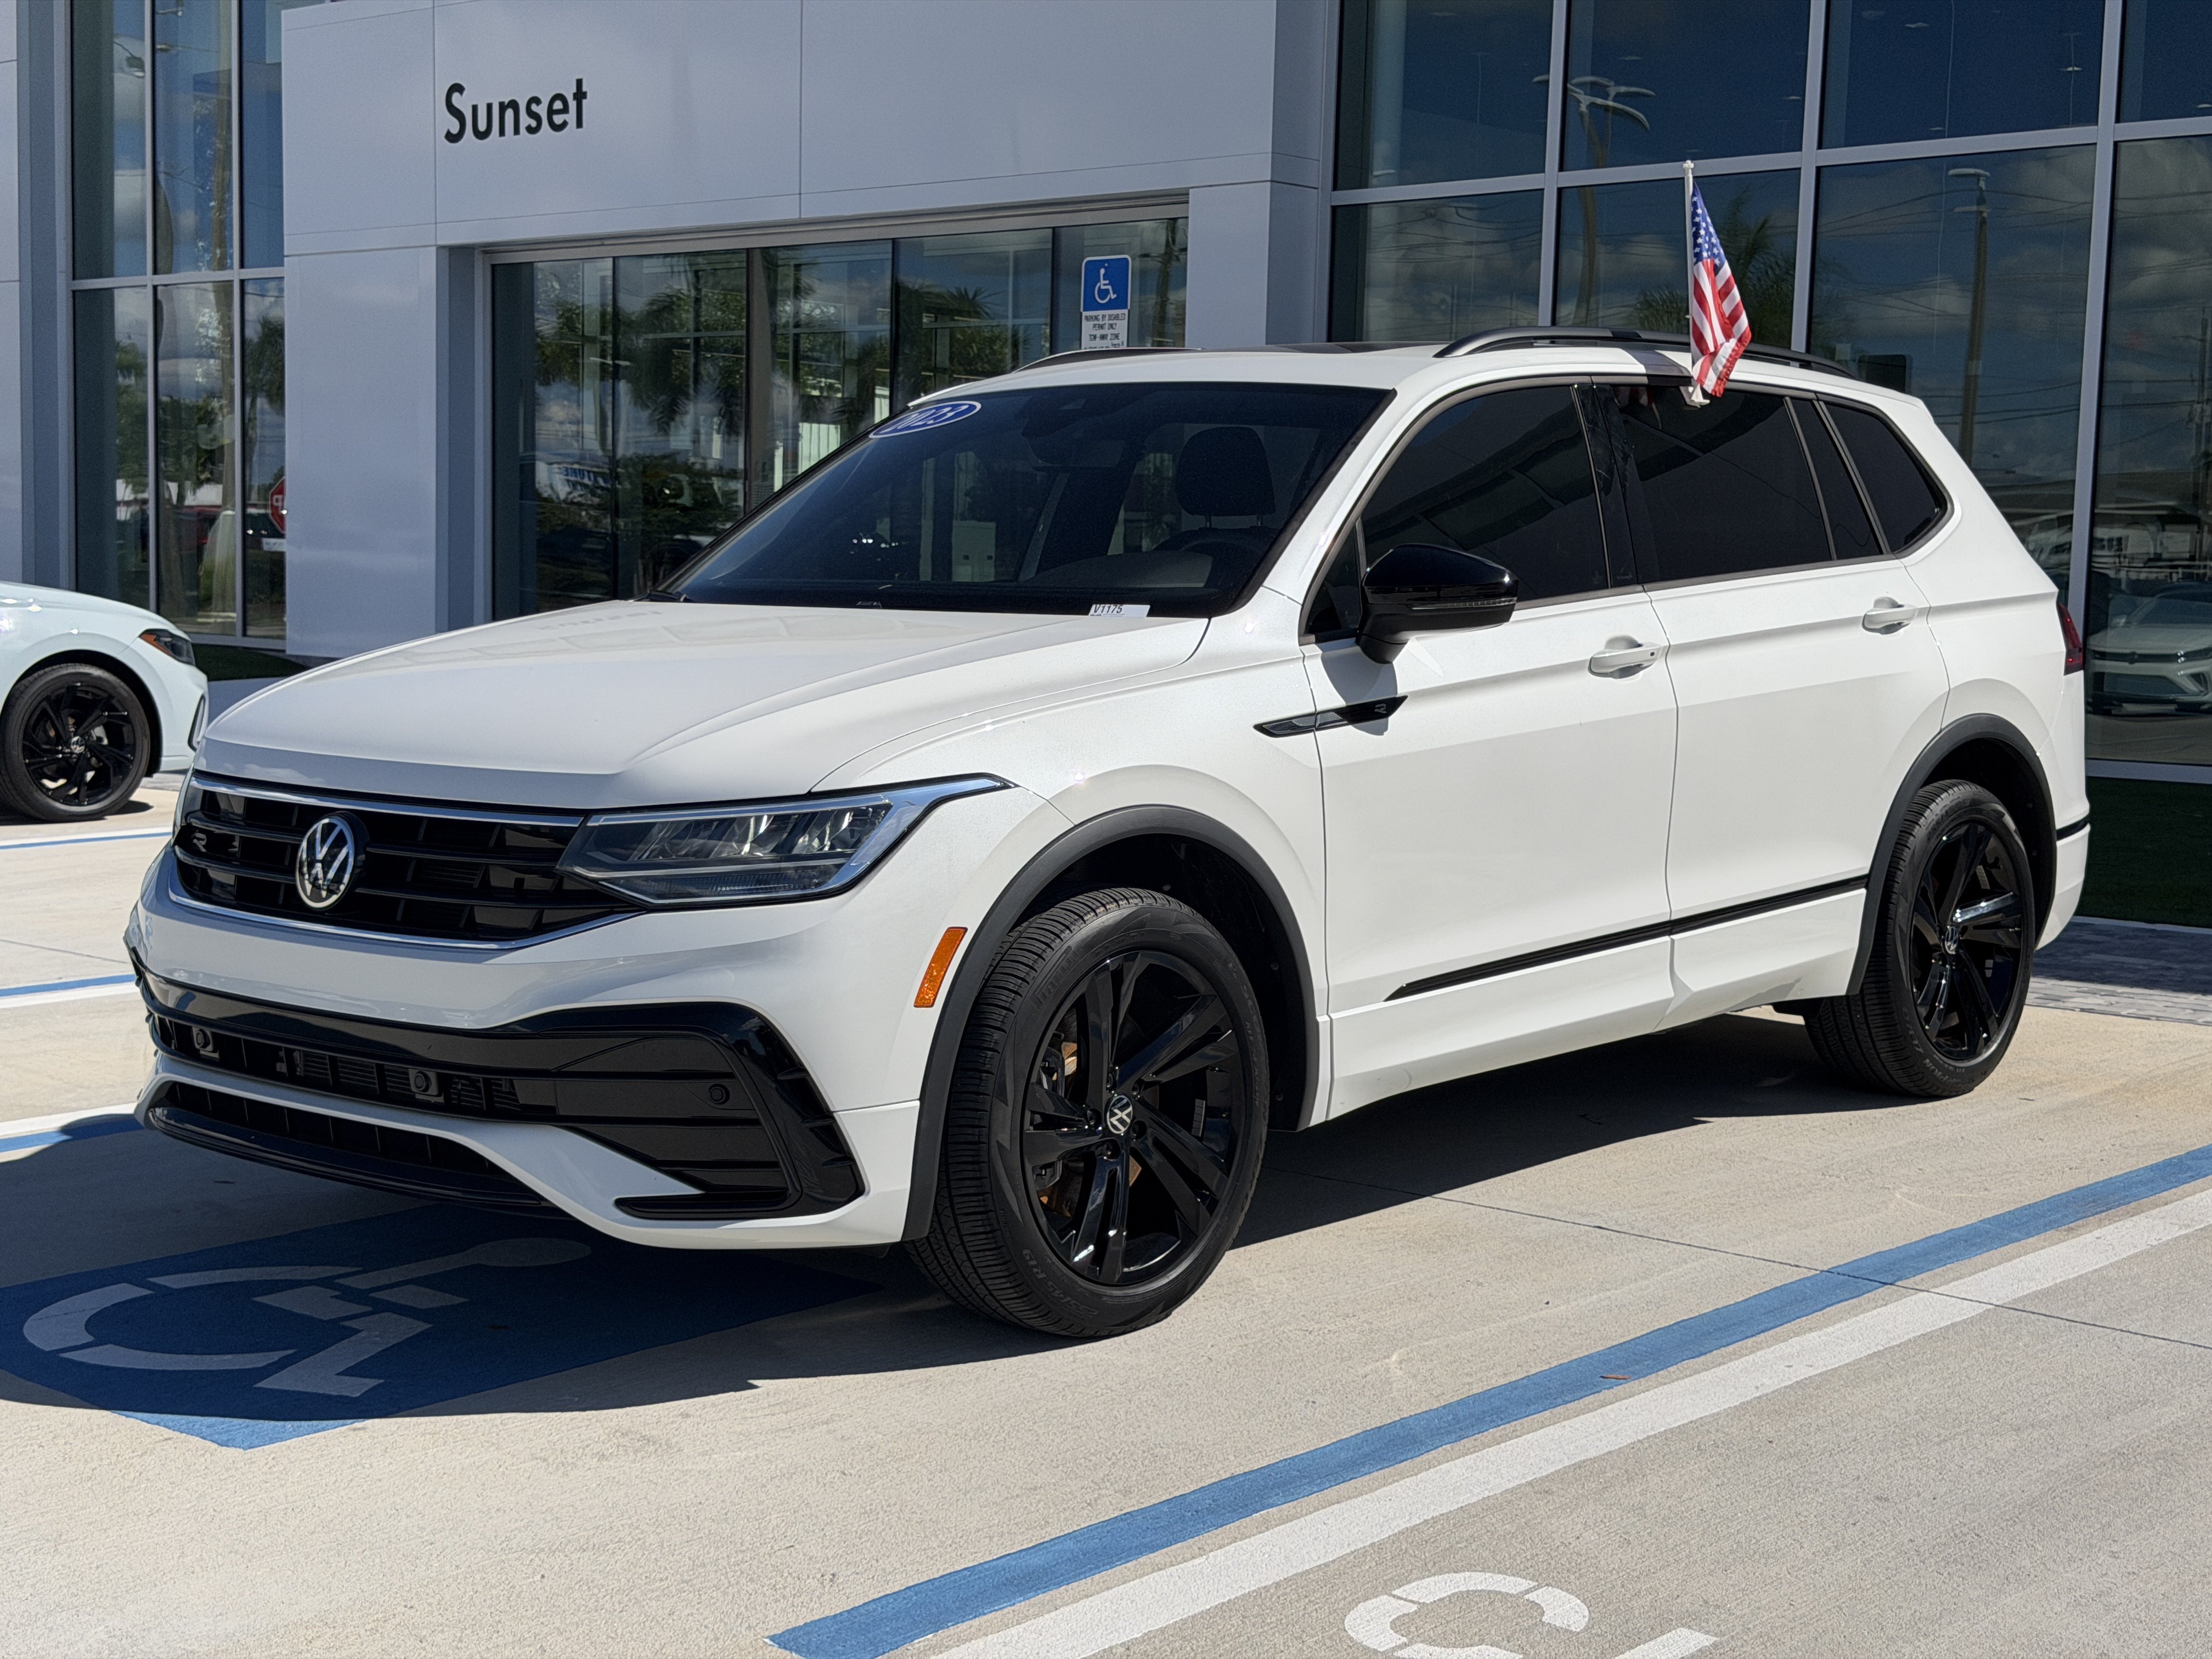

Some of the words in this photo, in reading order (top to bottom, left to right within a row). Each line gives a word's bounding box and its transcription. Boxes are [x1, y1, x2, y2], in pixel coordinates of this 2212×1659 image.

[444, 78, 588, 144] Sunset
[1093, 604, 1124, 614] V1175
[1022, 1249, 1047, 1279] R19
